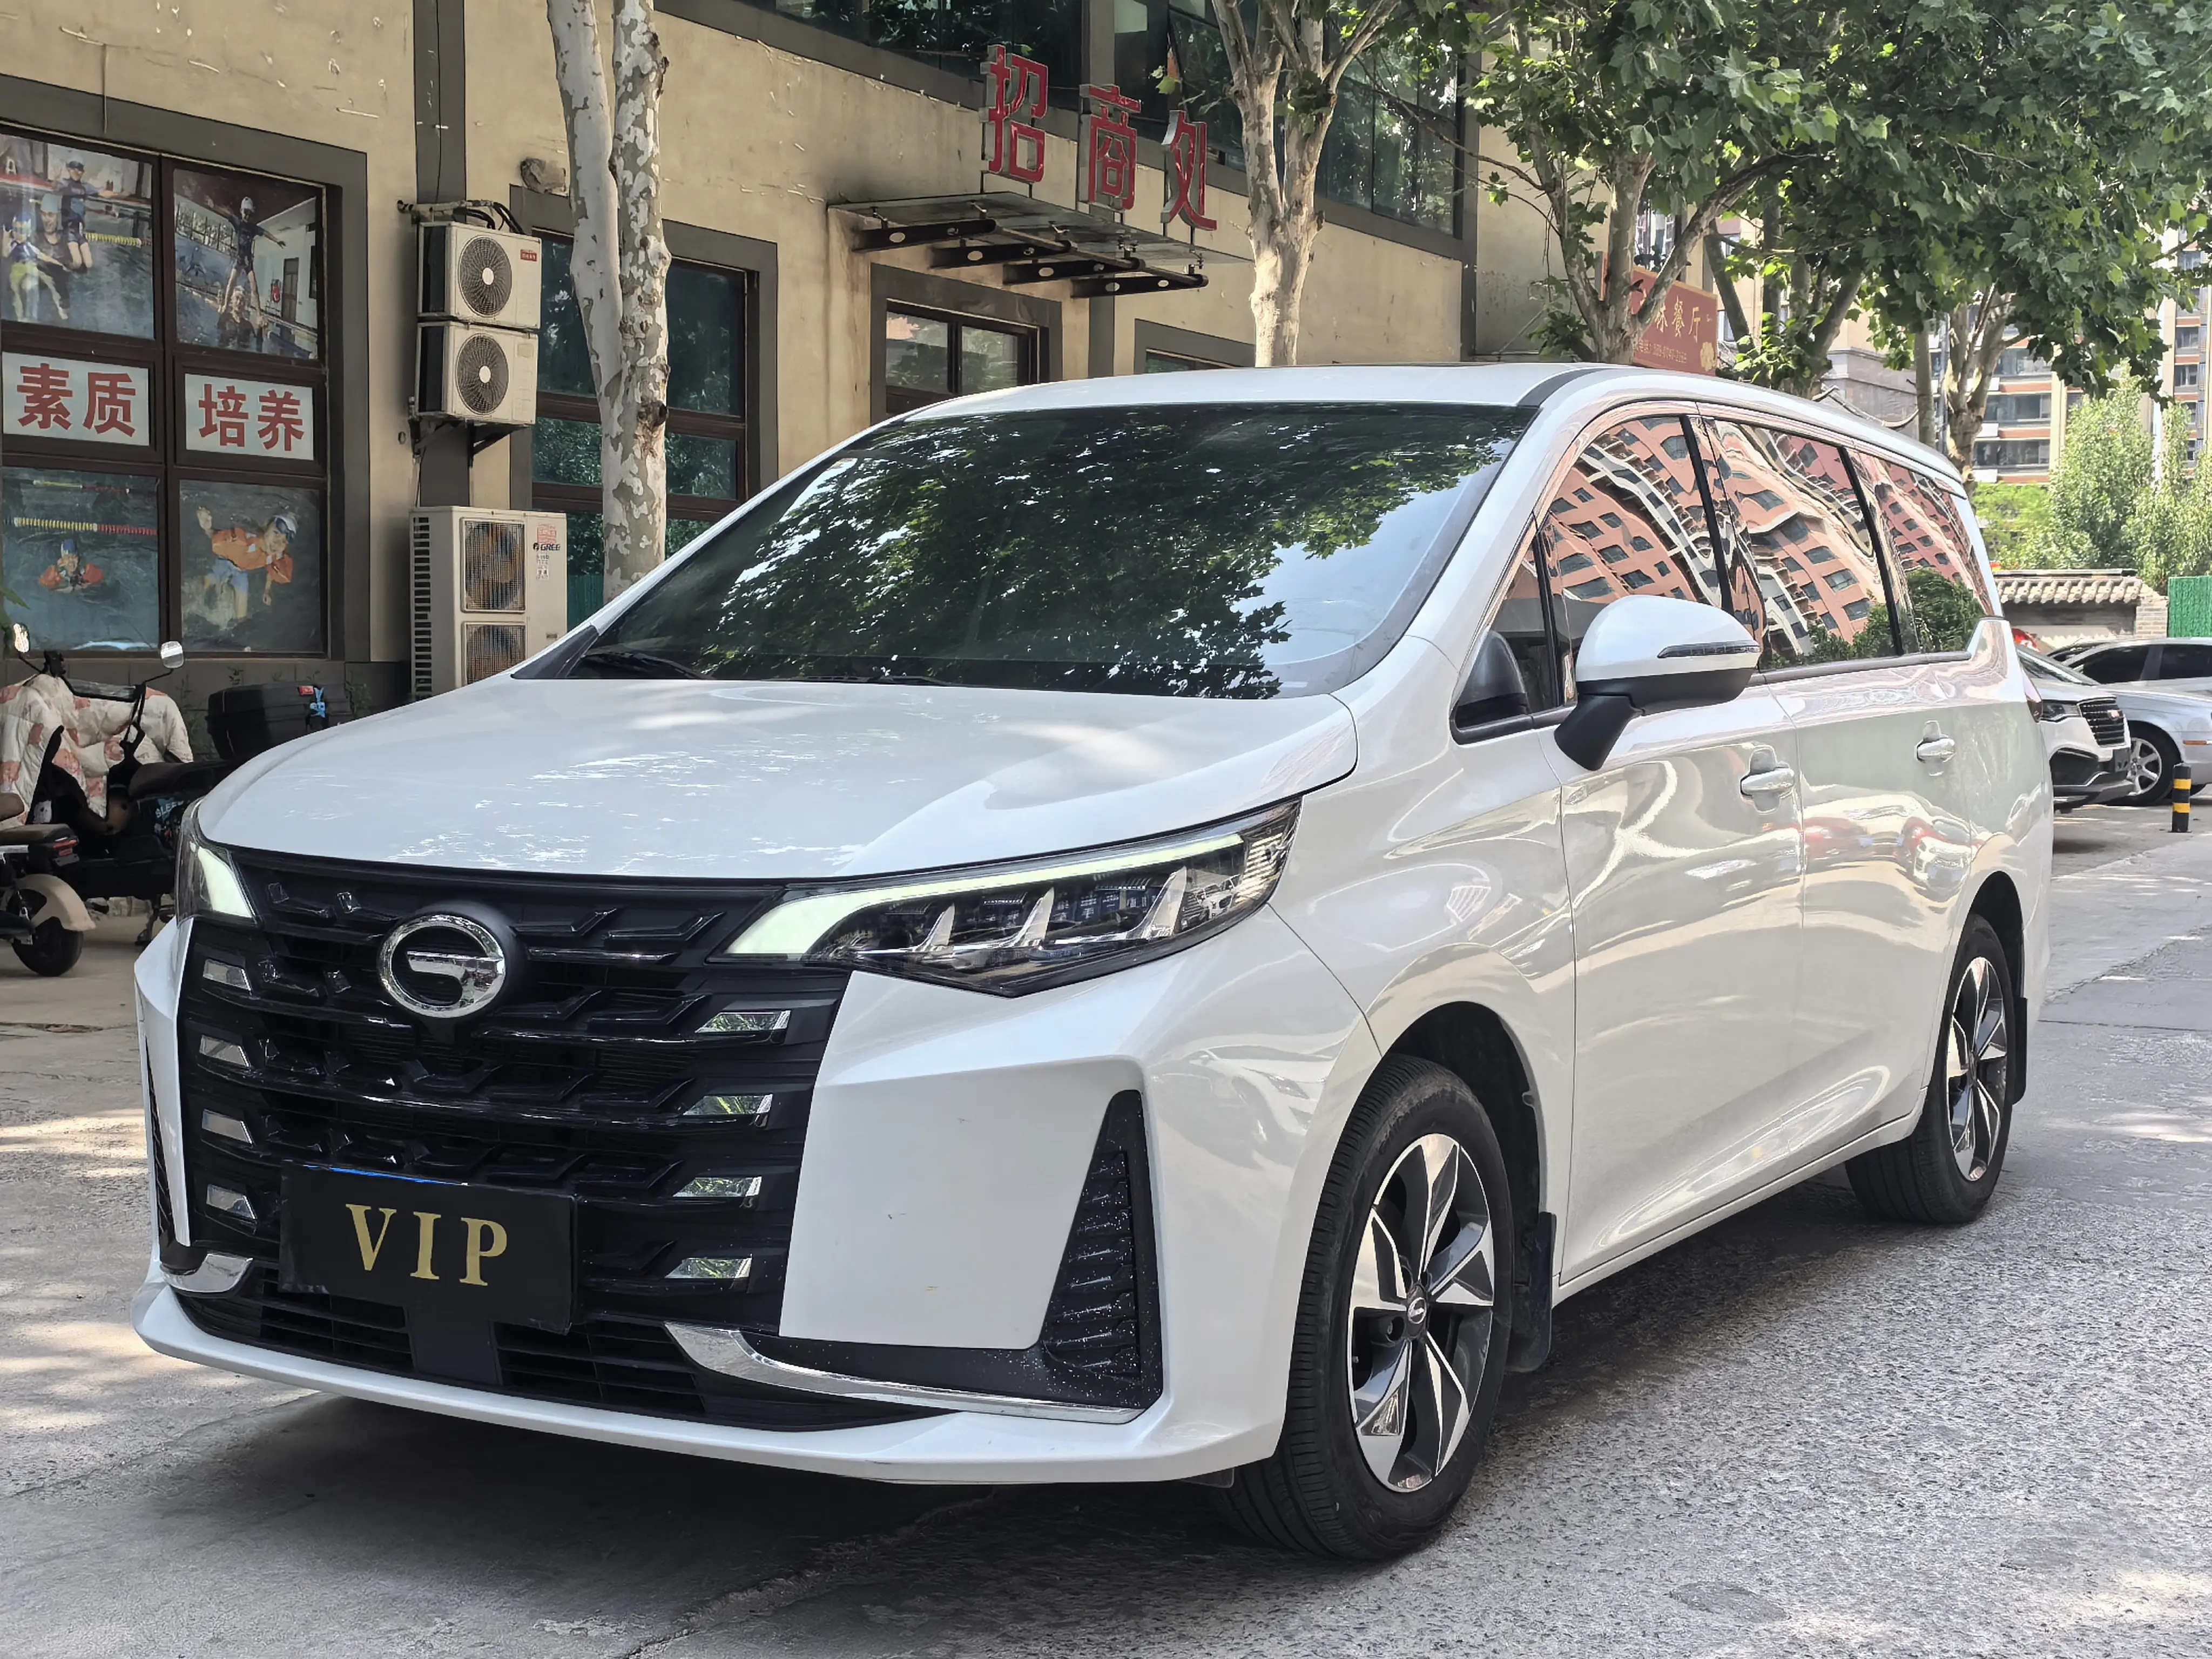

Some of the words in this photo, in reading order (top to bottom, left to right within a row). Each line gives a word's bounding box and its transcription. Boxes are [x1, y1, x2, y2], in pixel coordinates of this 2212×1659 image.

[981, 44, 1217, 231] 招商处
[17, 363, 136, 437] 素质
[199, 383, 304, 451] 培养
[346, 1204, 507, 1286] VIP
